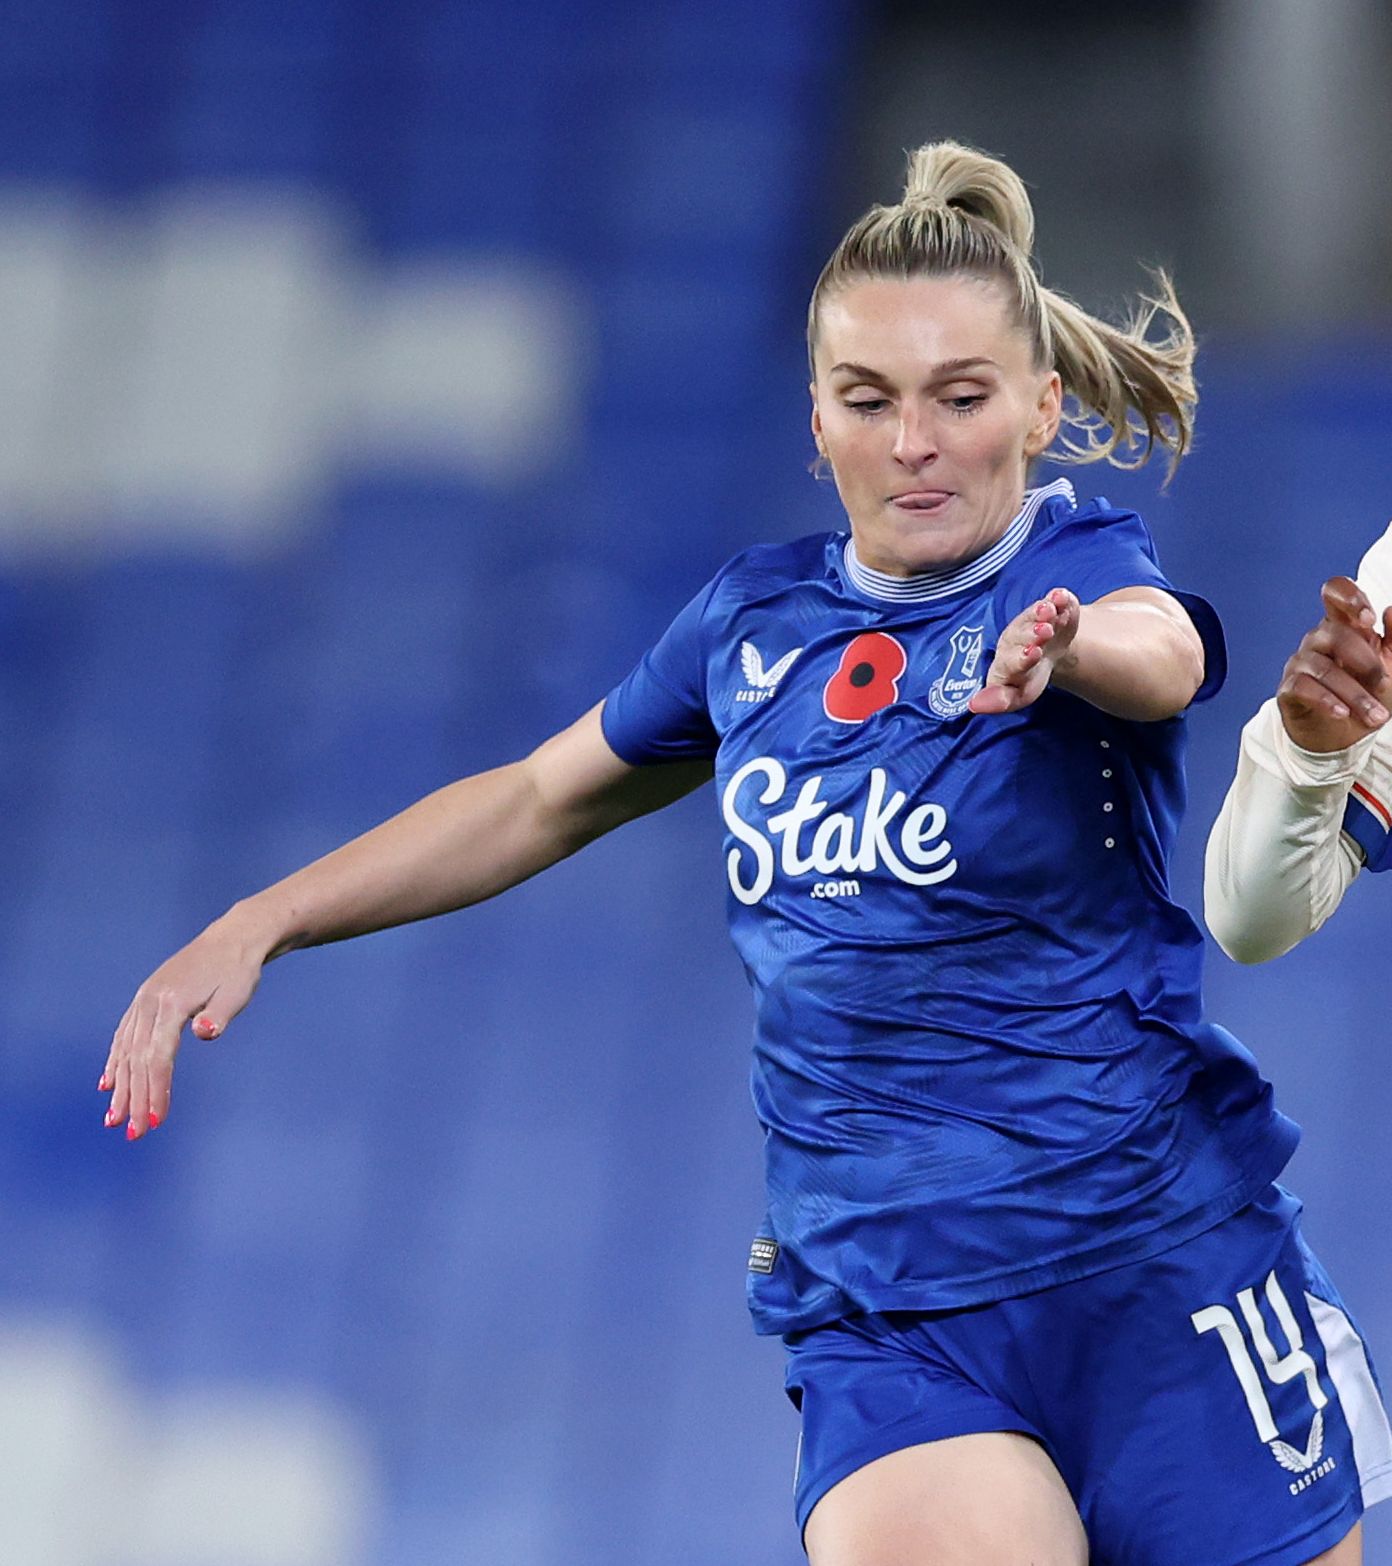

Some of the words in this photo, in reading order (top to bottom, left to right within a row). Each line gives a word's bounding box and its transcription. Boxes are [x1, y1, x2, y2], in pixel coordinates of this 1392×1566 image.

[722, 756, 957, 905] Stake
[809, 879, 861, 899] .com
[1191, 1269, 1328, 1443] 14
[1289, 1456, 1336, 1496] CASTORE
